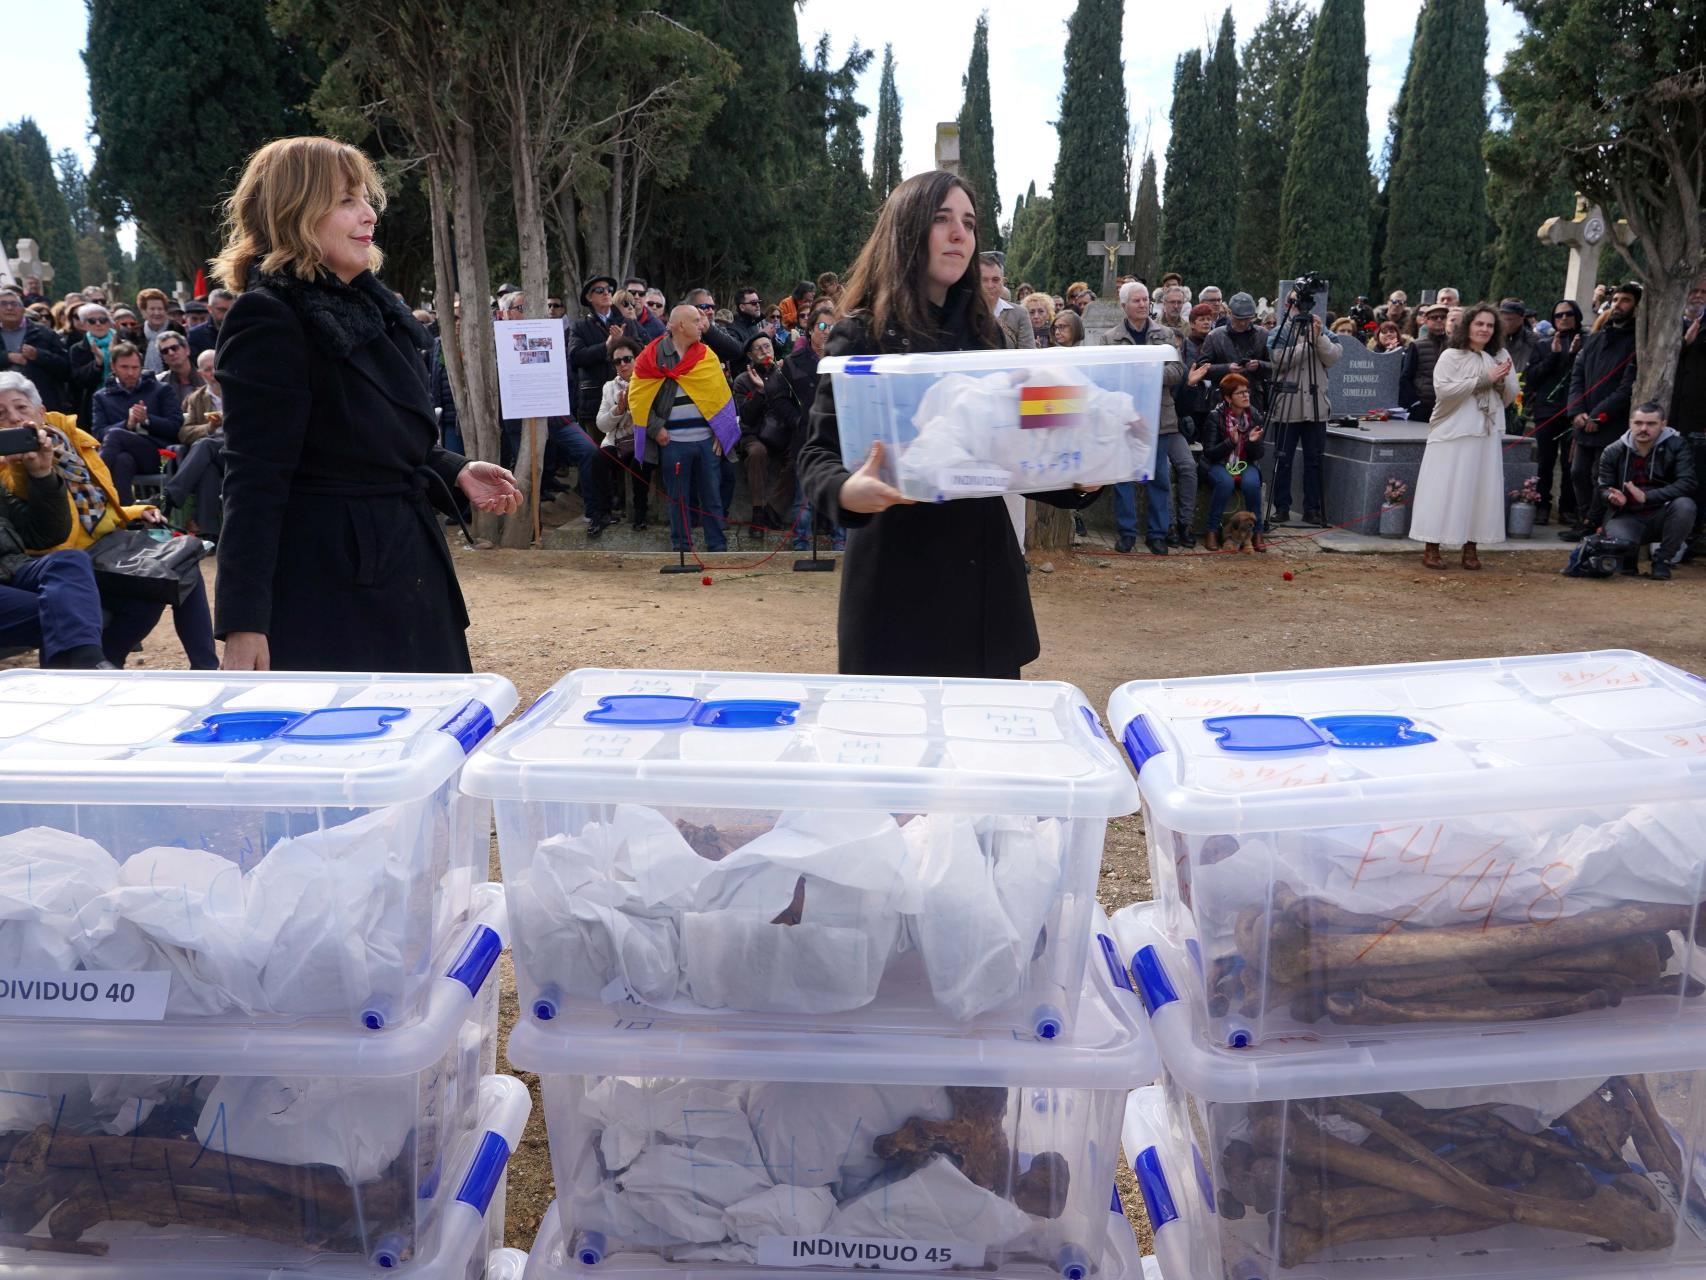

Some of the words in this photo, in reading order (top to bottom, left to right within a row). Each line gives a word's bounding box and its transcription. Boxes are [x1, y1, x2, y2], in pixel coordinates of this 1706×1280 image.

[1349, 360, 1375, 369] FAMILIA
[1343, 374, 1379, 383] FERNANDEZ
[1351, 823, 1576, 964] F4/48
[105, 982, 136, 1003] 40
[792, 1238, 918, 1264] INDIVIDUO
[924, 1247, 952, 1263] 45
